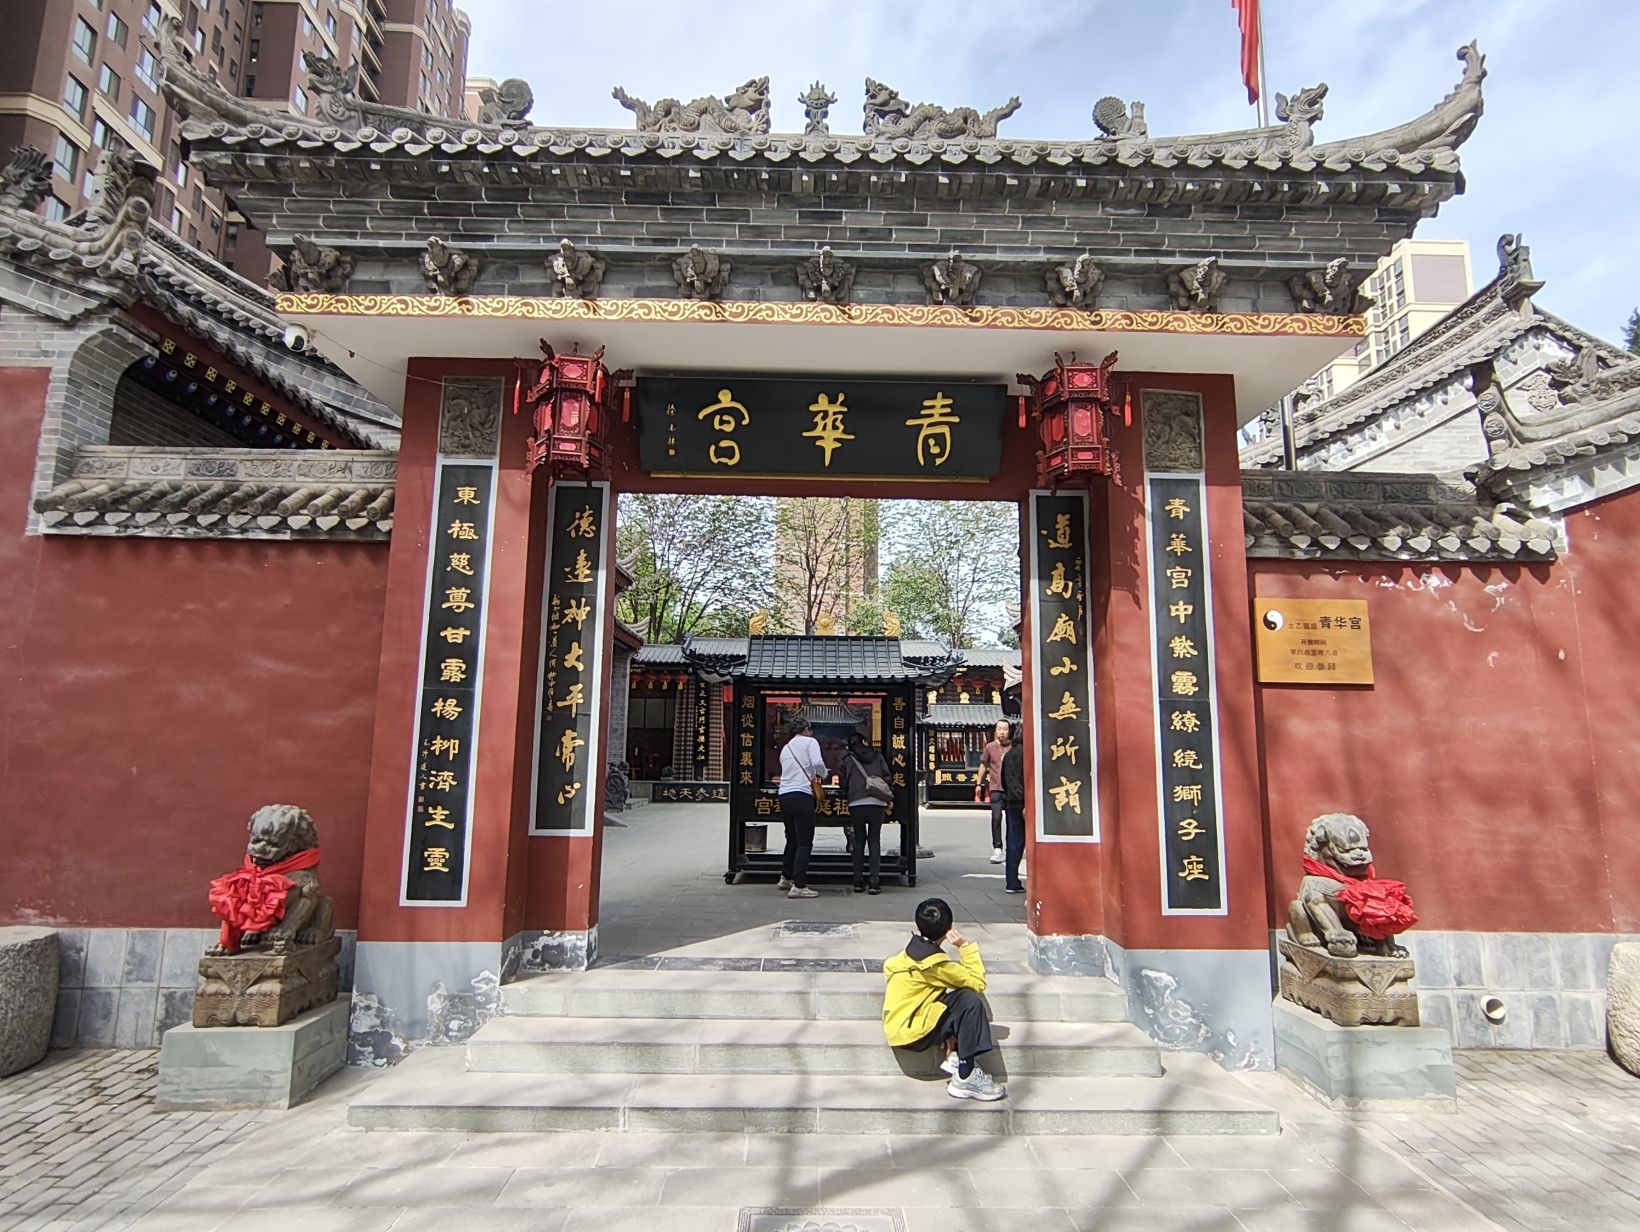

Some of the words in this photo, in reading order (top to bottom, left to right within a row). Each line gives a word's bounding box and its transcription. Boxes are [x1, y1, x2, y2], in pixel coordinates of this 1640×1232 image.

[1319, 616, 1361, 630] 青华宫
[892, 697, 906, 788] 香自誠心起
